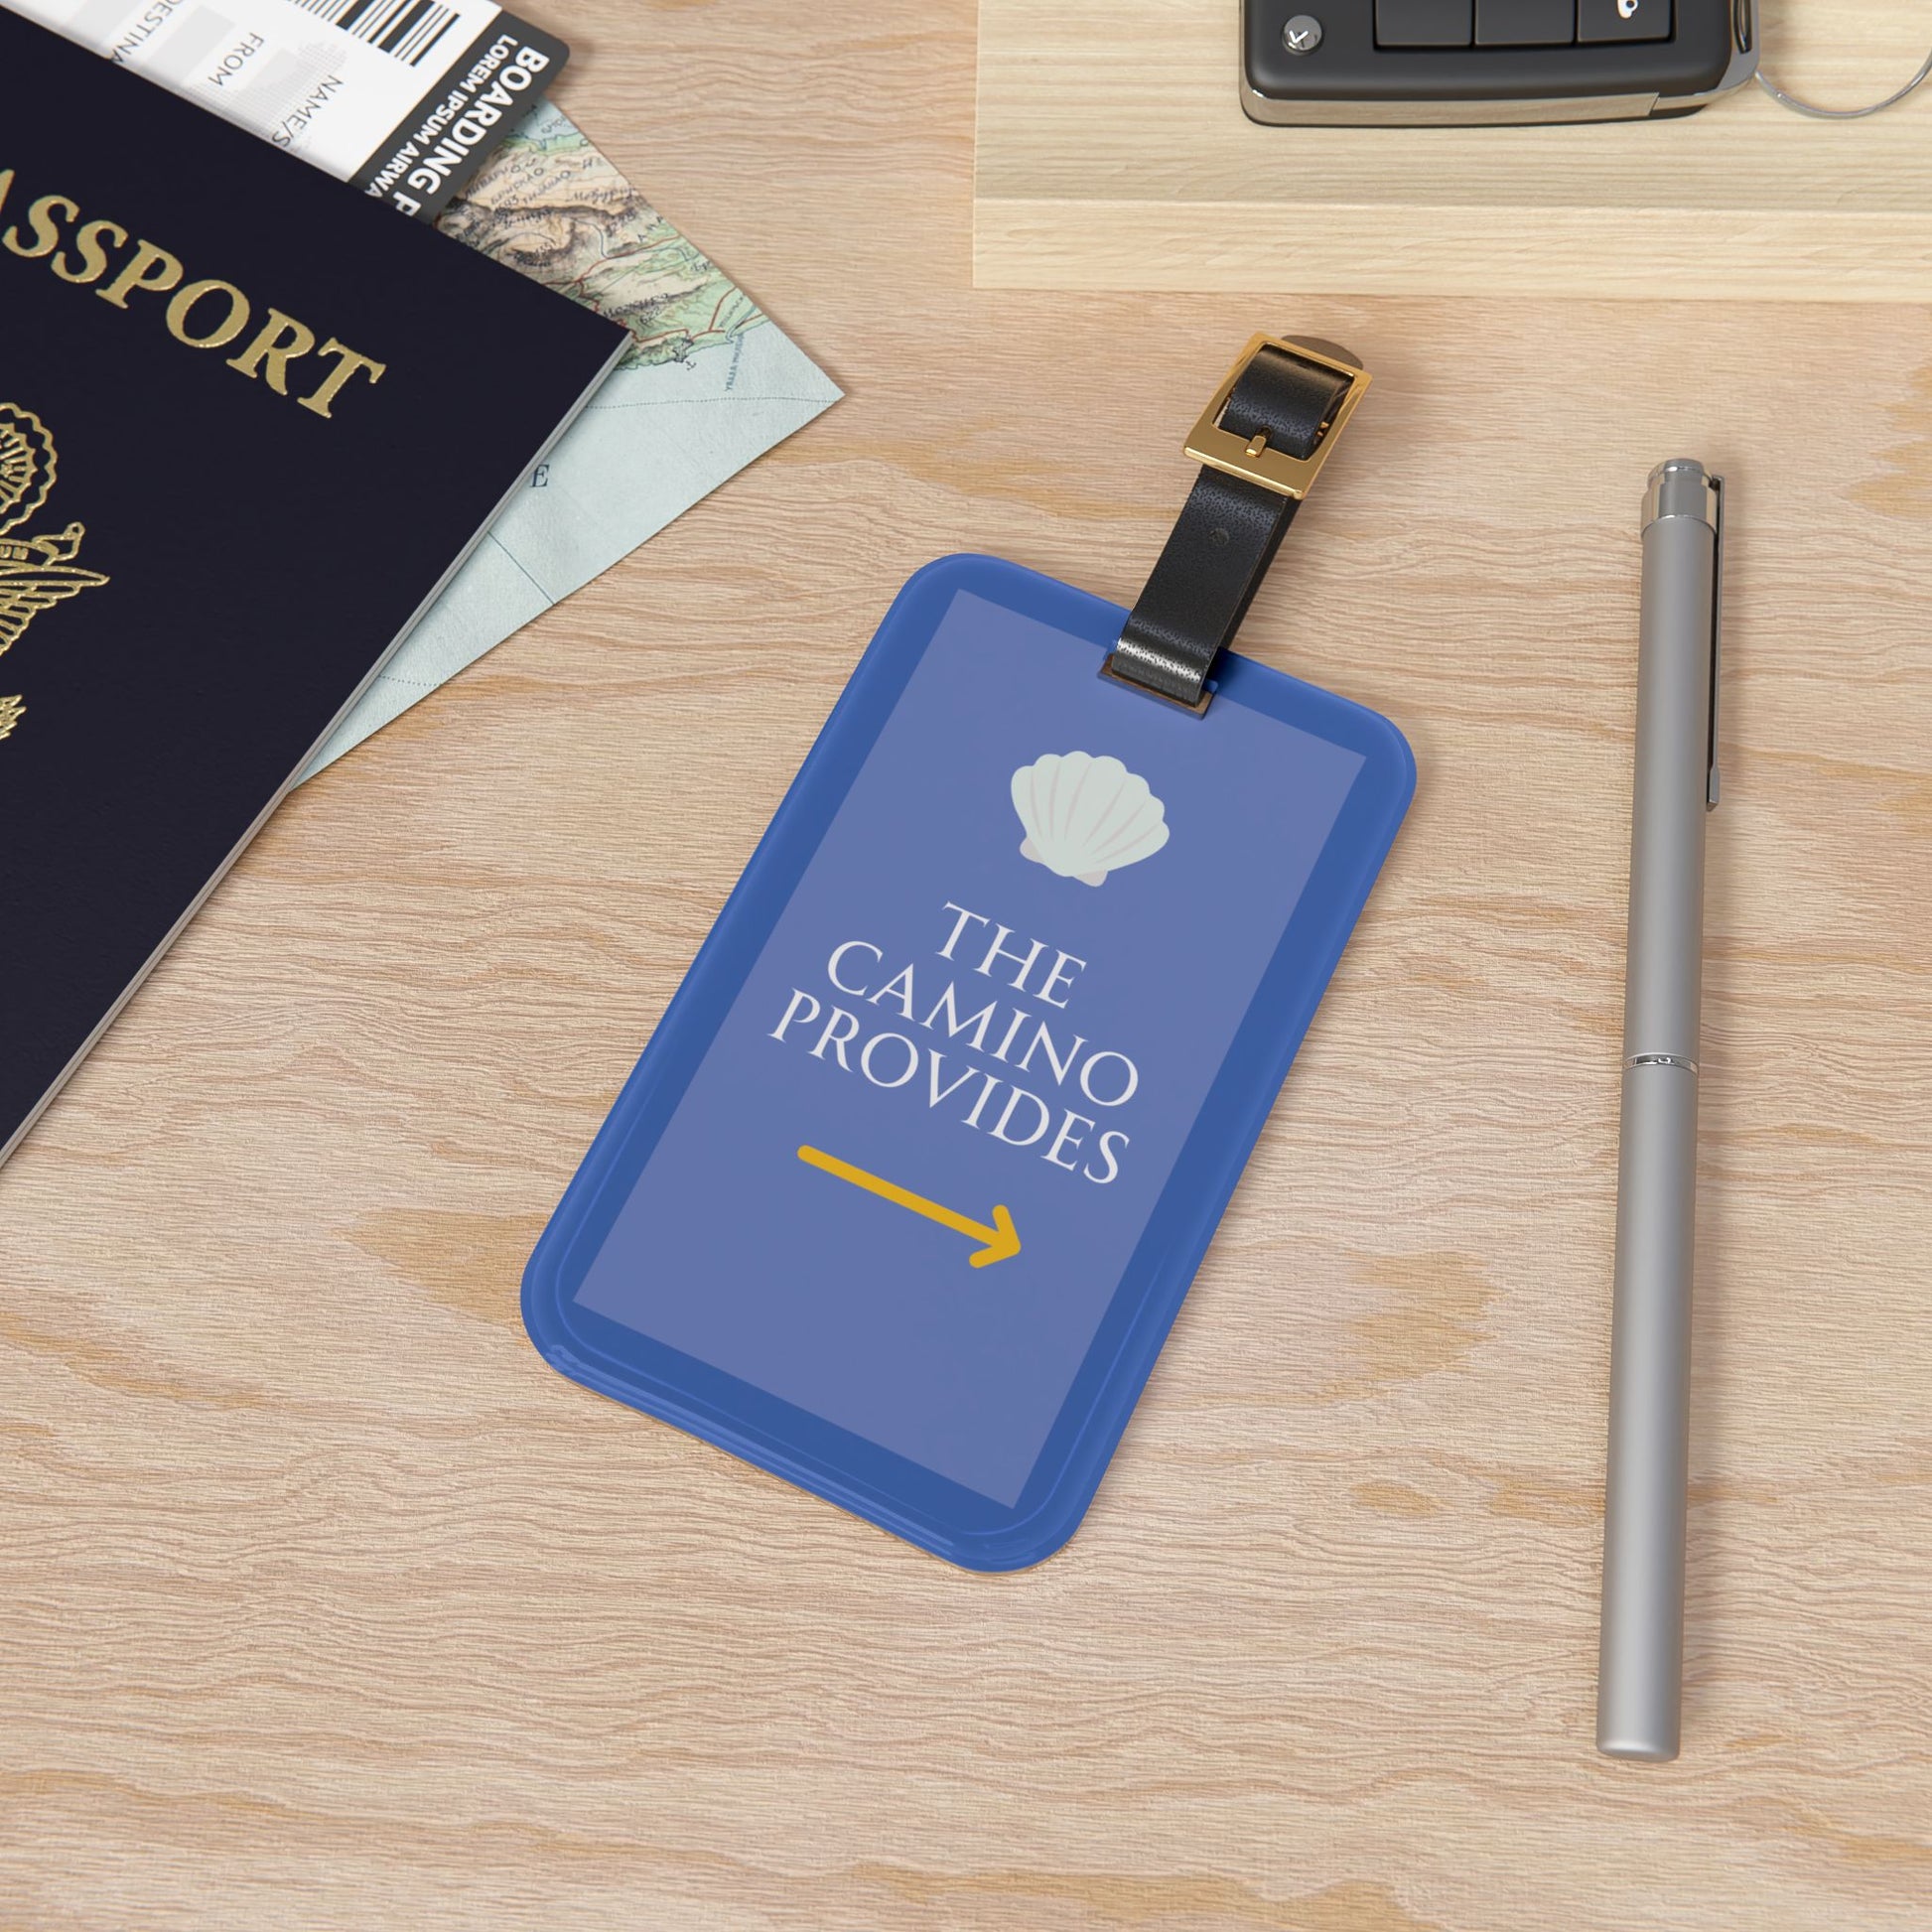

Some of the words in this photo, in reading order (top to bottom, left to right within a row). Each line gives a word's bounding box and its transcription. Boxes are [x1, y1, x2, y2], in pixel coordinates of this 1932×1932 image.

[207, 32, 265, 87] FROM
[459, 34, 519, 94] LOREM
[271, 74, 345, 148] NAME/S
[407, 46, 550, 195] BOARDING
[413, 89, 469, 146] IPSUM
[364, 141, 420, 199] AIRWA
[393, 191, 422, 217] P
[934, 900, 1087, 1009] THE
[827, 940, 1139, 1107] CAMINO
[766, 987, 1130, 1184] PROVIDES
